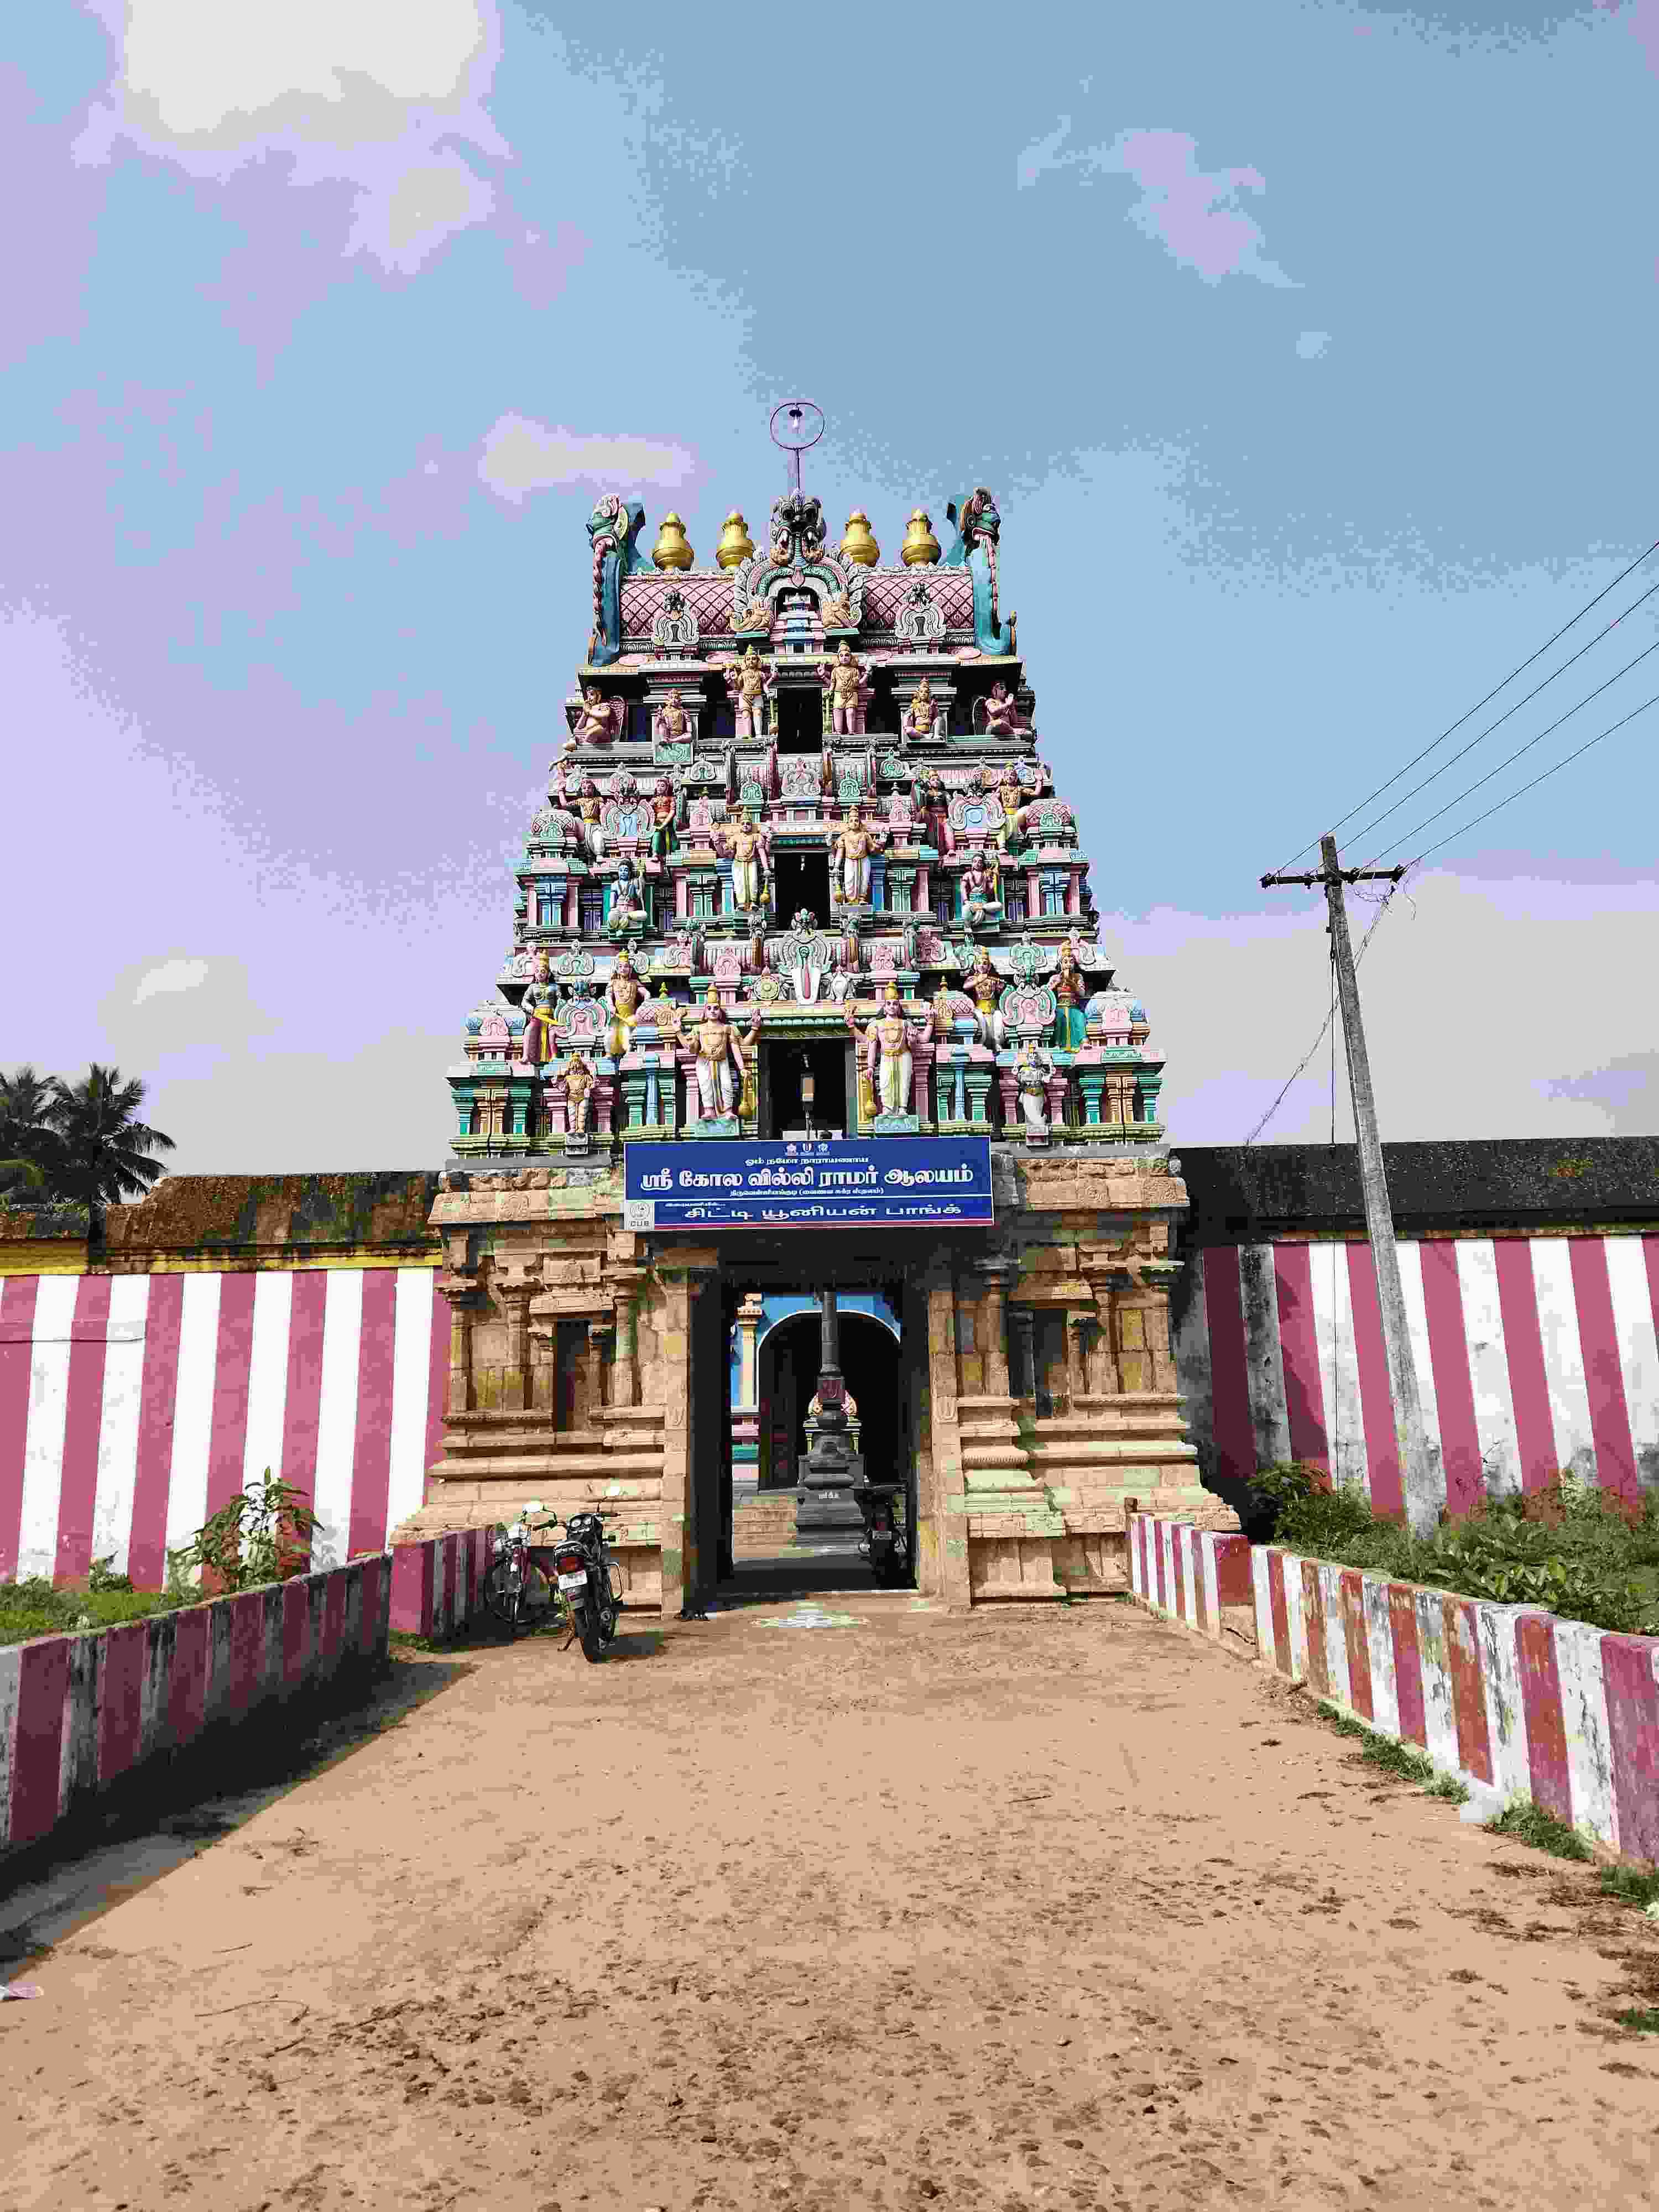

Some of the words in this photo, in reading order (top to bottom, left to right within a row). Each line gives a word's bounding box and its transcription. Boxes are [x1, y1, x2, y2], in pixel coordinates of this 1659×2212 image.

[640, 1168, 673, 1191] ஸ்ரீ
[679, 1170, 743, 1187] கோல
[748, 1166, 815, 1186] வில்லி
[818, 1165, 878, 1187] ராமர்
[884, 1163, 973, 1186] ஆலயம்
[684, 1207, 753, 1220] சிட்டி
[761, 1204, 878, 1220] யூனியன்
[886, 1204, 961, 1215] பாங்க்
